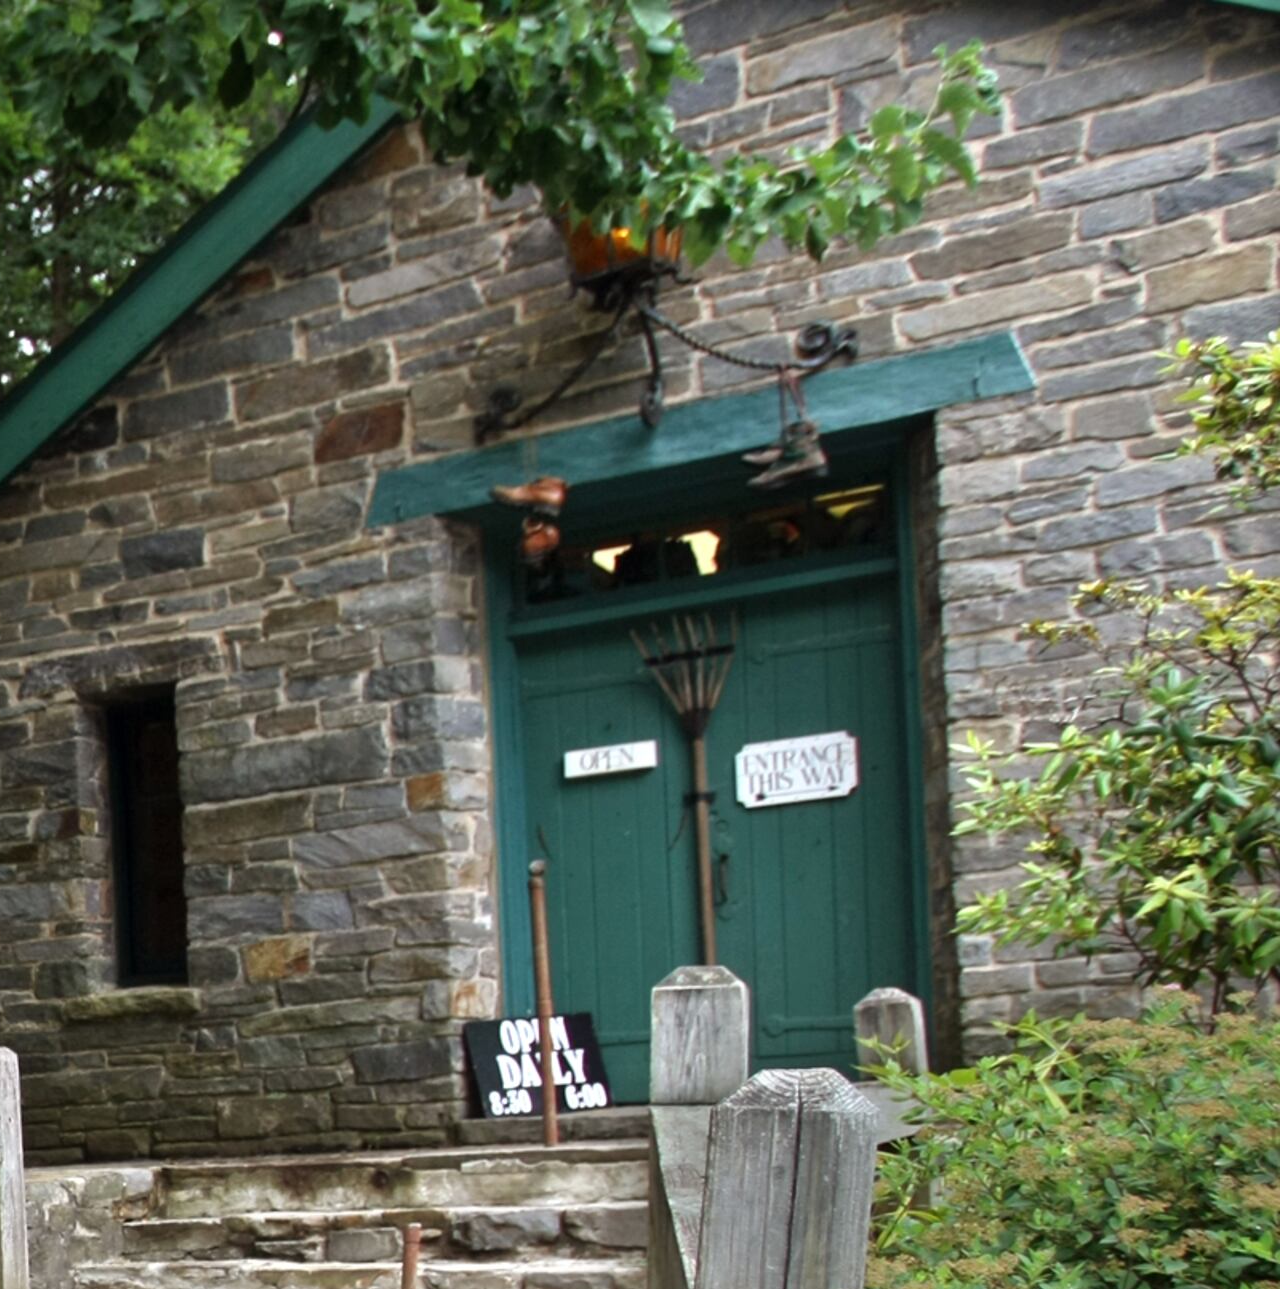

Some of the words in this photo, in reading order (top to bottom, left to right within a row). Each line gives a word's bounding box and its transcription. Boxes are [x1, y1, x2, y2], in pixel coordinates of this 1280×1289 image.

[580, 746, 634, 771] OPEN
[743, 743, 853, 775] ENTRANCE
[749, 771, 793, 795] THIS
[801, 766, 845, 786] WAY
[496, 1049, 587, 1089] DALY
[489, 1088, 533, 1116] 8:30
[565, 1082, 608, 1110] 6:00
